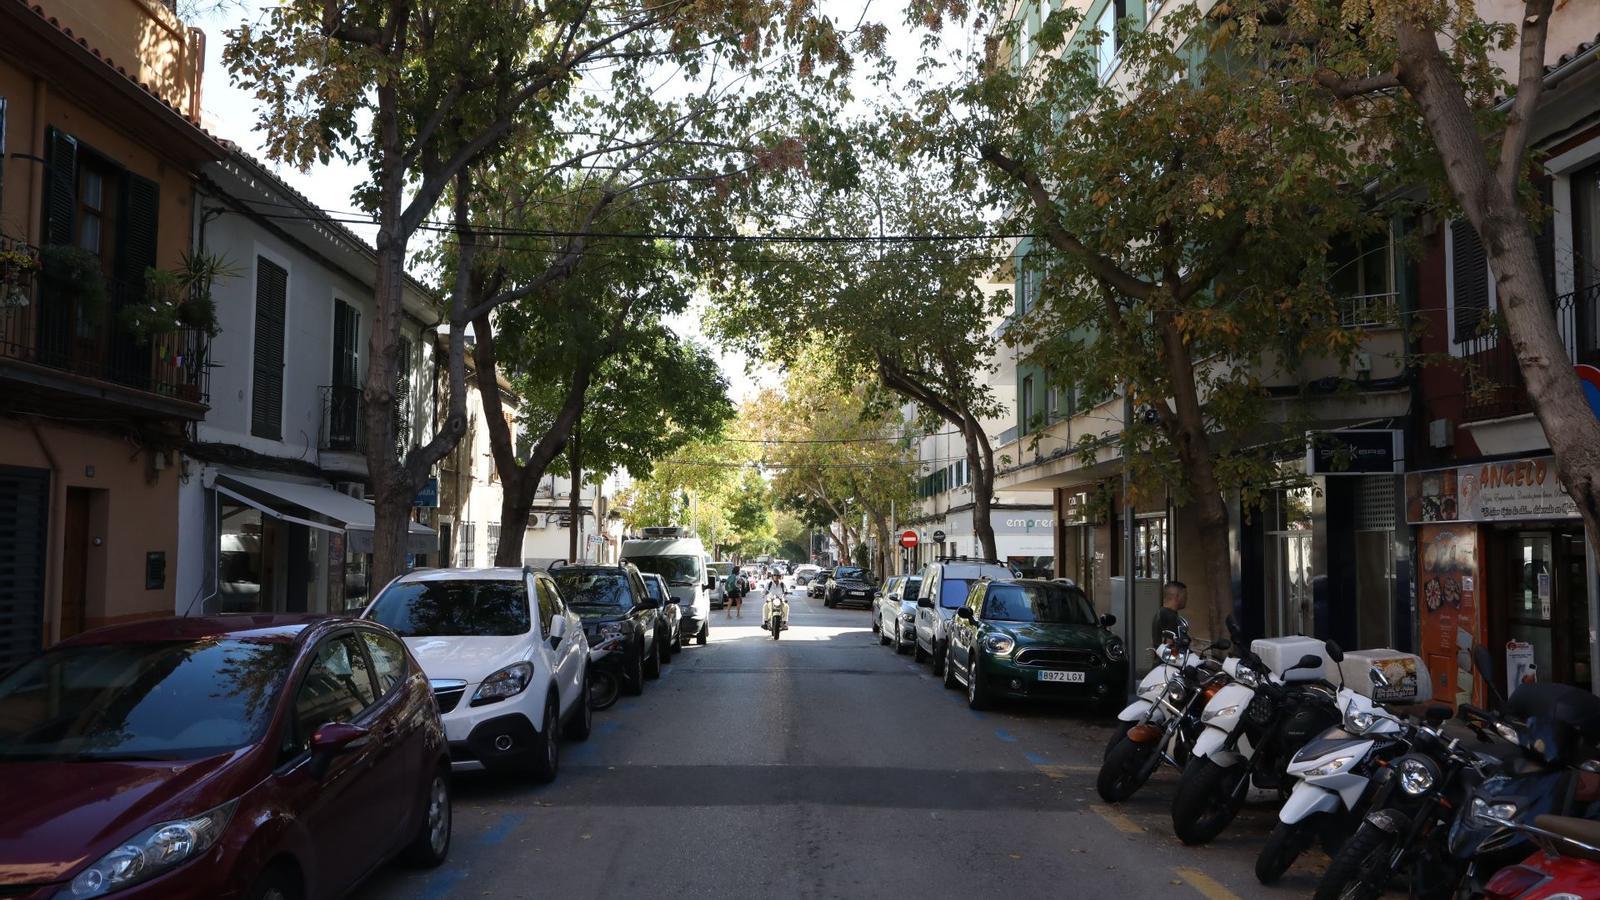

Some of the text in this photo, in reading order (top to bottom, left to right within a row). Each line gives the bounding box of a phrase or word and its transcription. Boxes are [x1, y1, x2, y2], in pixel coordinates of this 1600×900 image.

[1480, 459, 1548, 489] ANGELO
[1043, 671, 1083, 682] 8972 LGX
